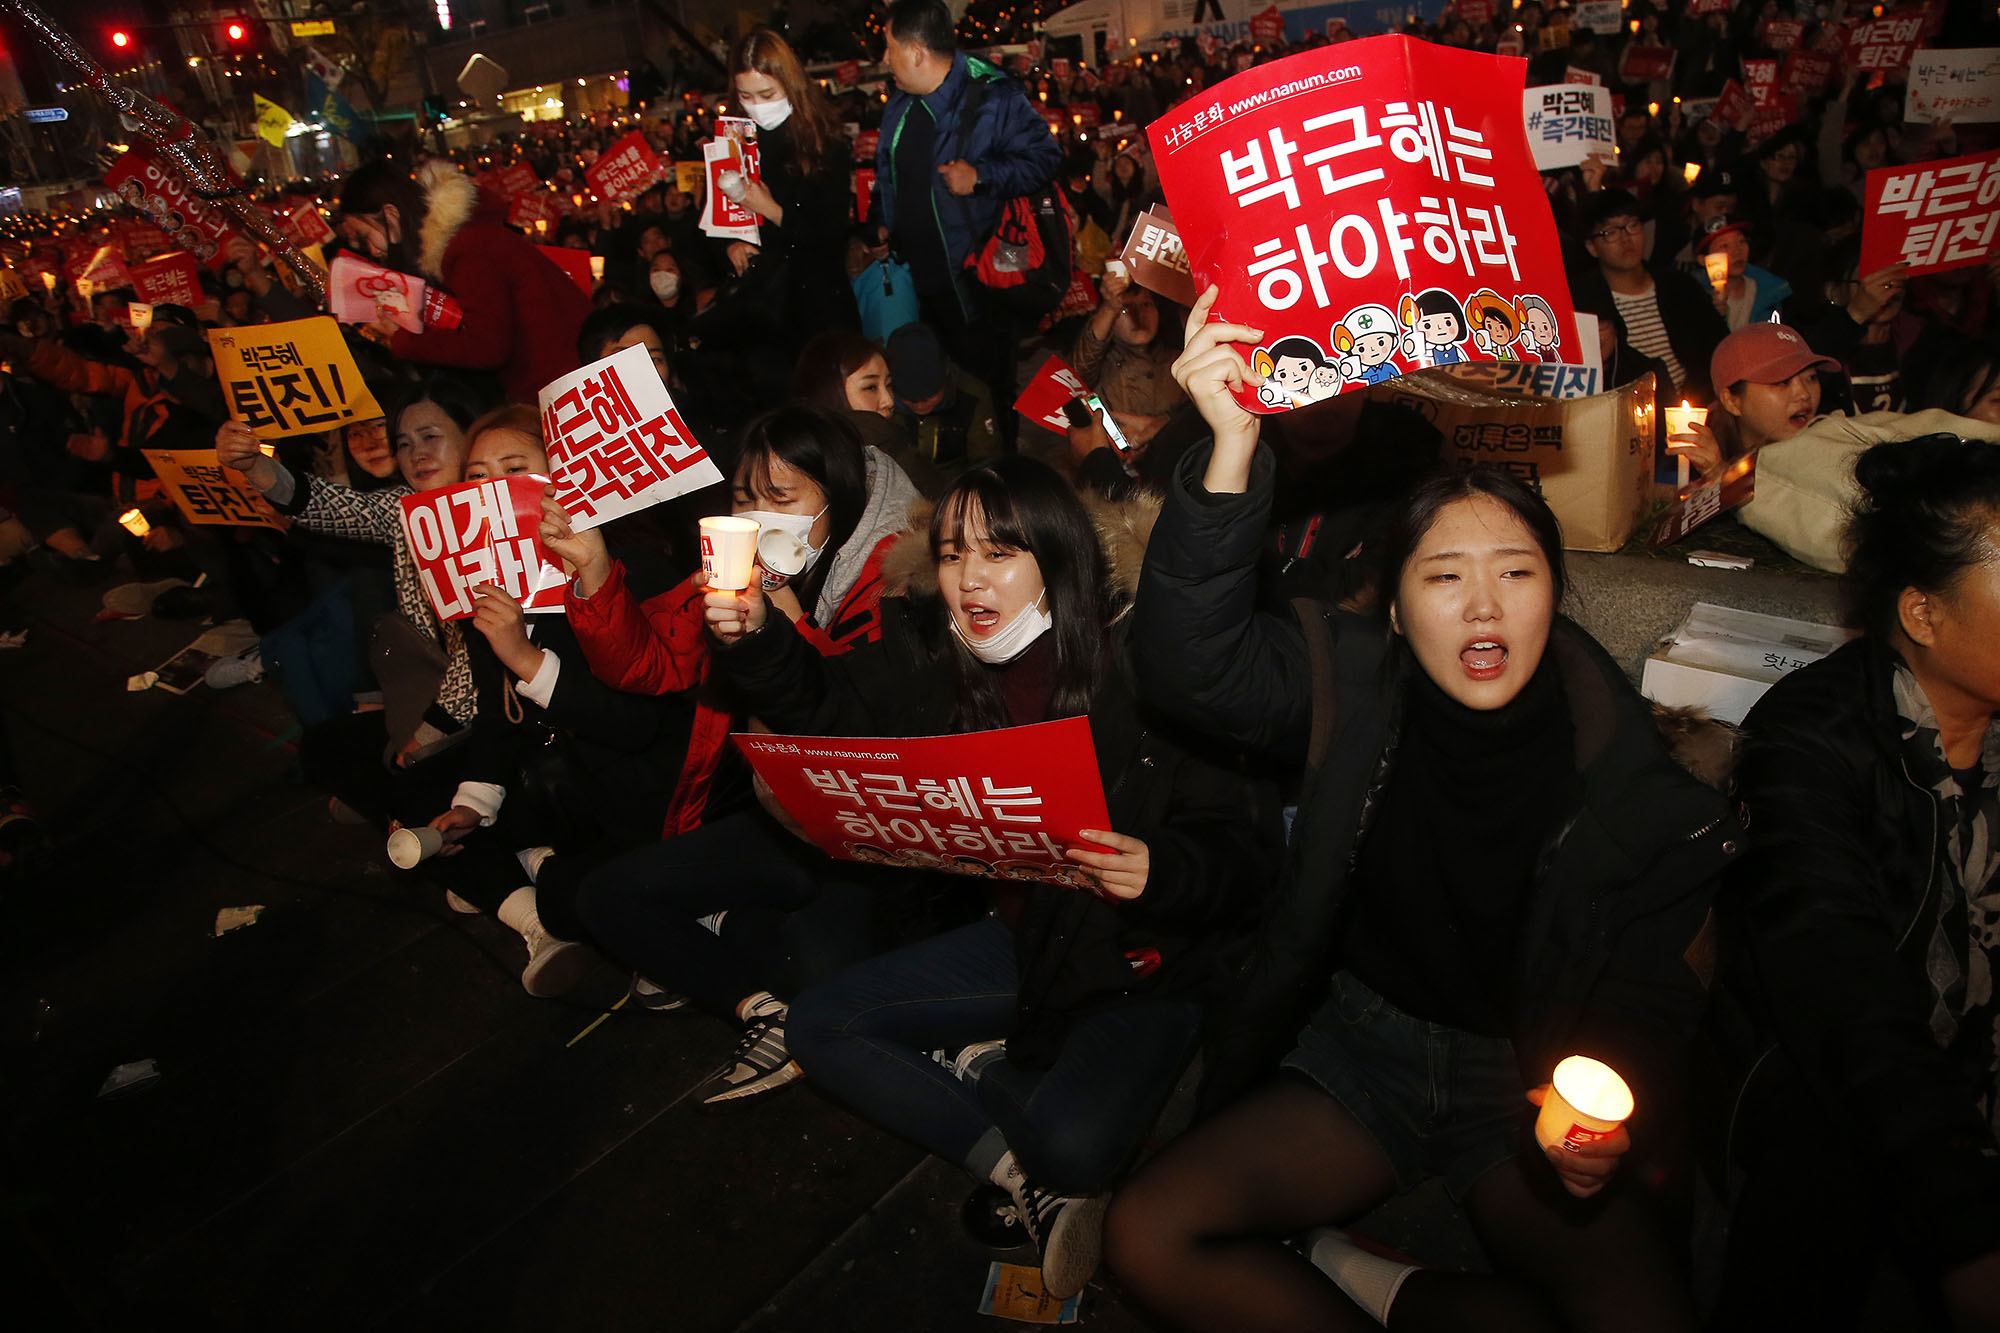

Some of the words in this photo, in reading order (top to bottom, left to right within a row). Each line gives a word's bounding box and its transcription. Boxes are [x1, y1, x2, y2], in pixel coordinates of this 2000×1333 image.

[1164, 102, 1225, 147] 나눔문화
[1229, 65, 1361, 116] www.nanum.com
[1543, 91, 1595, 116] 박근혜
[1220, 100, 1496, 210] 박근혜는
[1247, 196, 1521, 311] 하야하라
[1897, 210, 2000, 267] 퇴진
[239, 341, 304, 373] 박근혜
[231, 363, 354, 431] 퇴진!
[542, 365, 643, 464] 박근혜
[552, 408, 709, 518] 즉각퇴진
[1454, 423, 1531, 452] 하루온
[181, 465, 229, 484] 박근혜
[409, 479, 519, 561] 이게
[804, 749, 899, 760] www.nanum.com
[802, 767, 1042, 823] 박근혜는
[835, 810, 1064, 860] 하야하라
